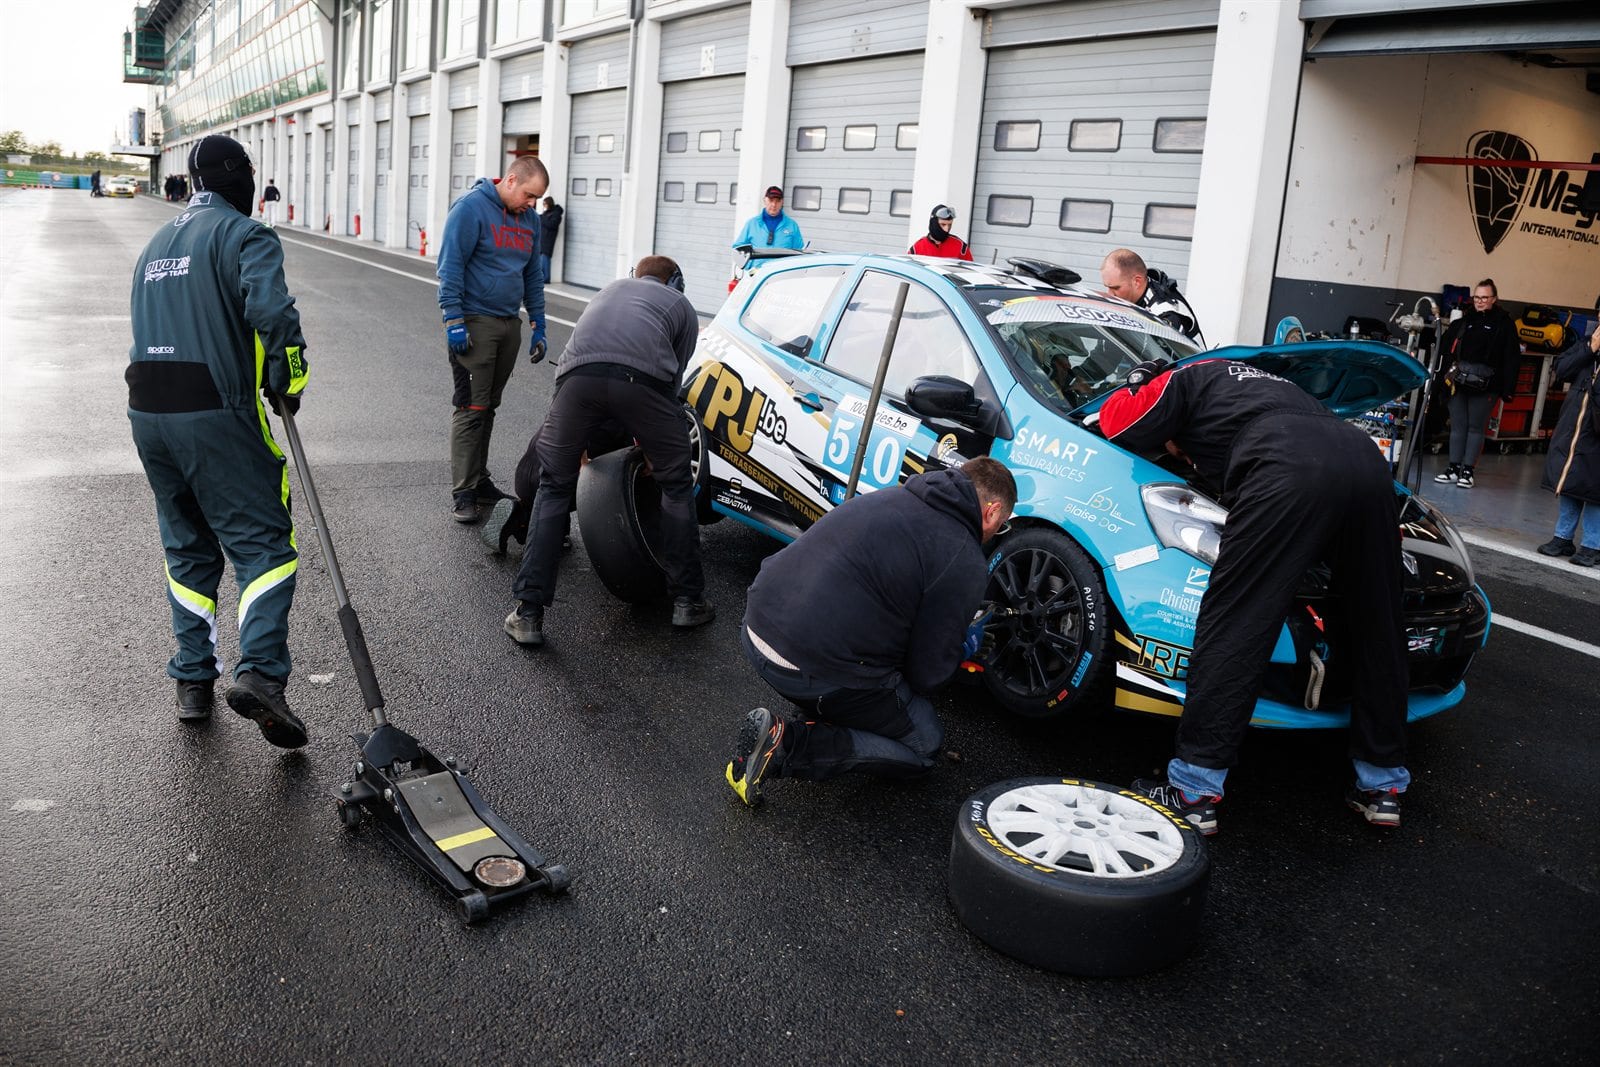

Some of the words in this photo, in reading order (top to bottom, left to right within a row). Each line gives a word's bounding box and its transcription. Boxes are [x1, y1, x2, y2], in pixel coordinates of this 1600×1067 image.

[491, 224, 535, 253] VANS
[1520, 221, 1599, 245] INTERNATIONAL
[169, 268, 189, 277] TEAM
[1521, 329, 1543, 338] STANLEY
[147, 346, 175, 354] sparco
[828, 417, 899, 485] 50
[1015, 428, 1098, 466] SMART
[1008, 450, 1086, 482] ASSURANCES
[720, 445, 779, 493] TERRASSEMENT
[783, 490, 820, 523] CONTAIN
[1064, 503, 1097, 522] Blaise
[1160, 587, 1200, 614] Christo
[1119, 789, 1192, 830] PIRELLI
